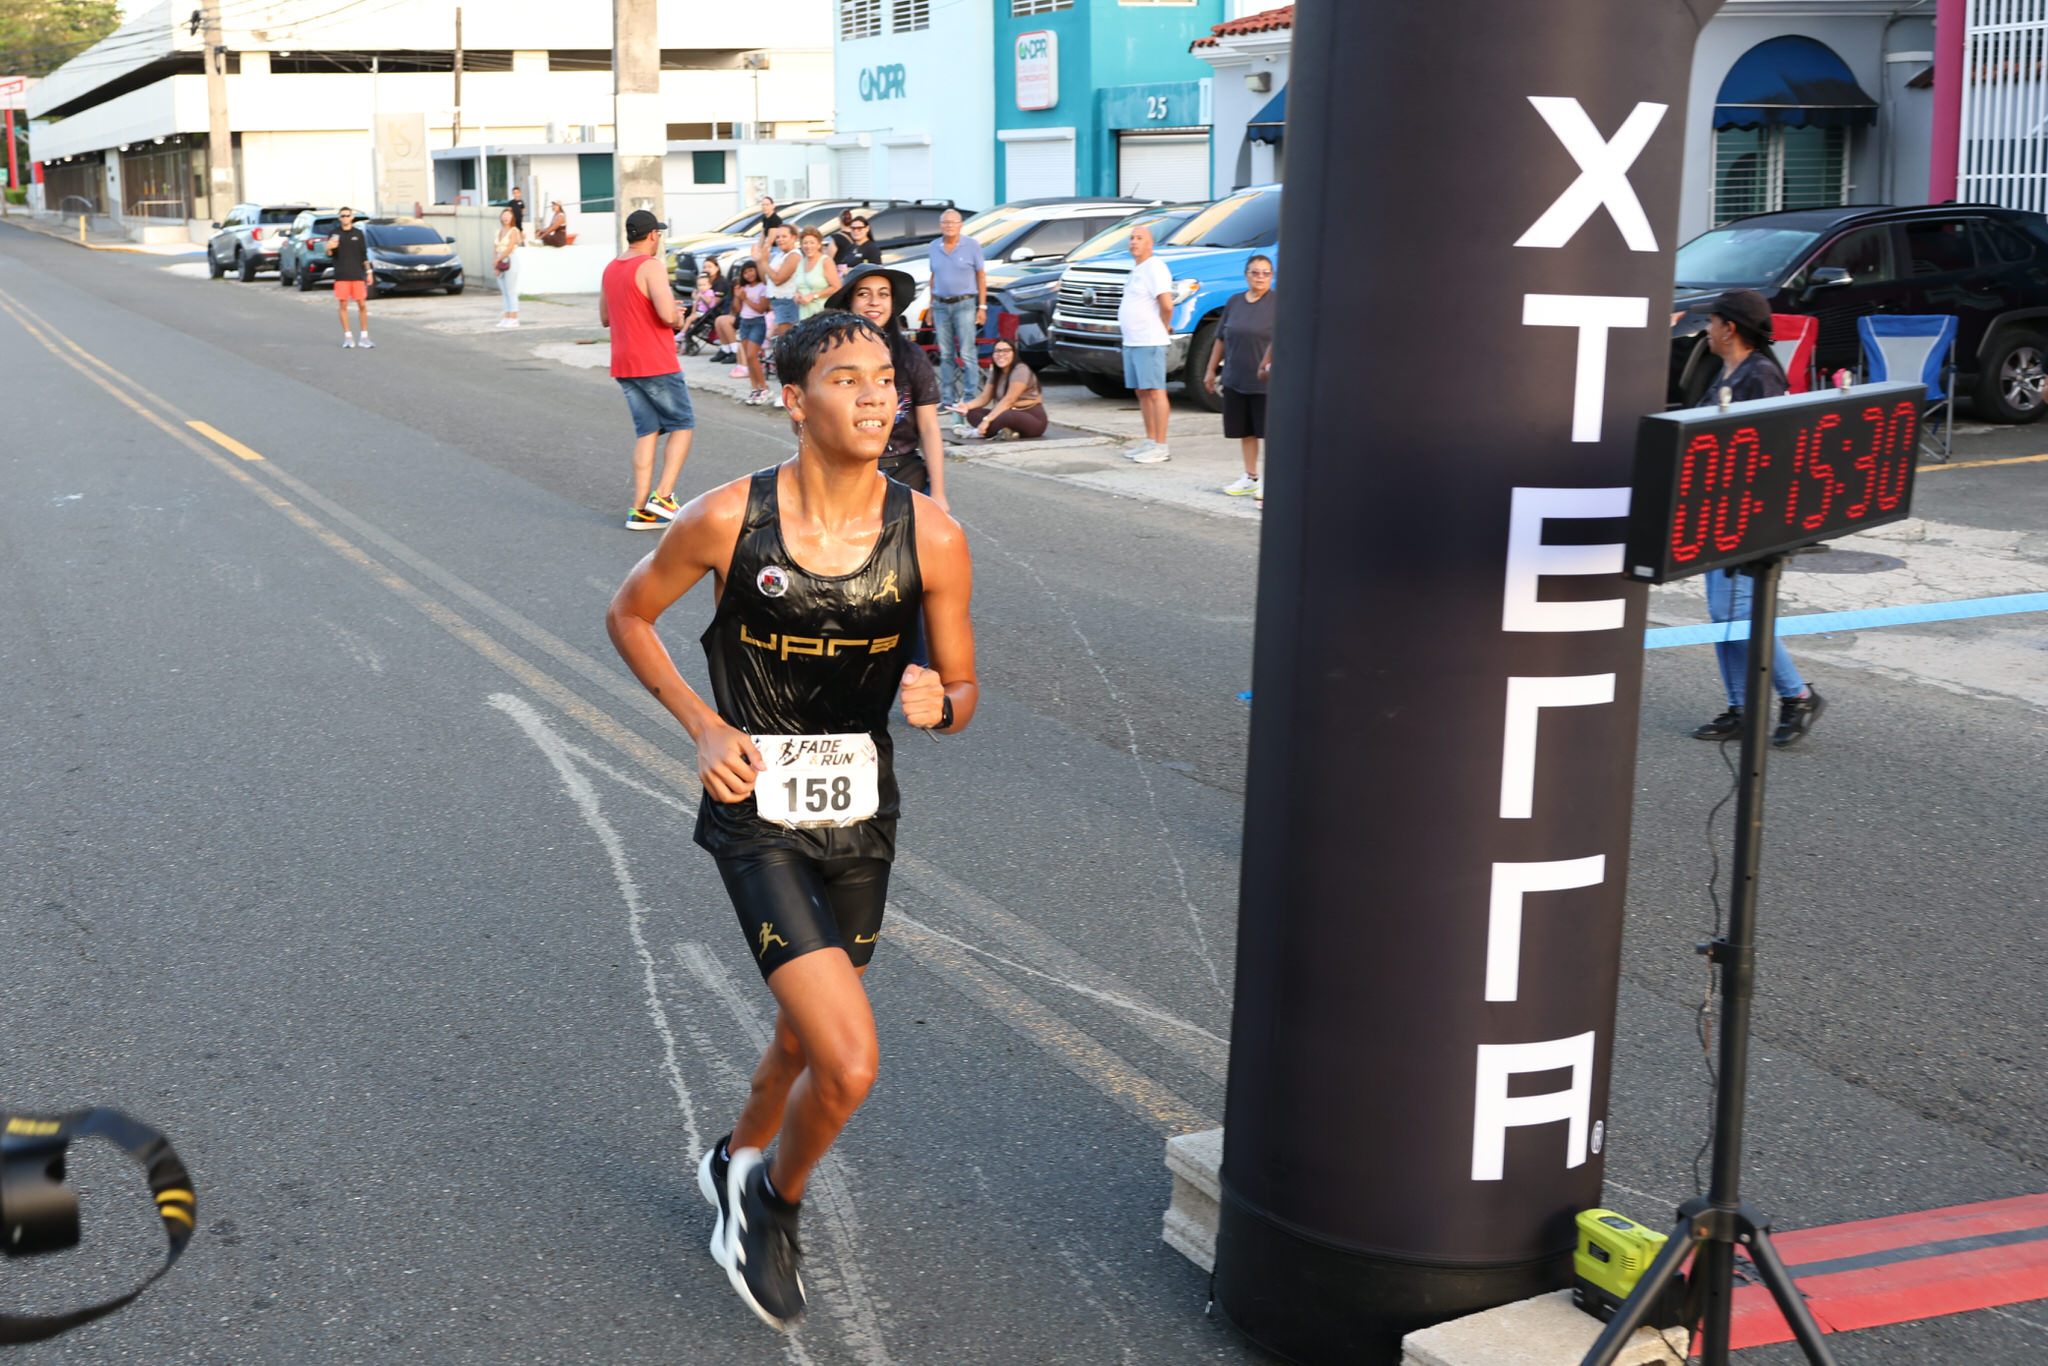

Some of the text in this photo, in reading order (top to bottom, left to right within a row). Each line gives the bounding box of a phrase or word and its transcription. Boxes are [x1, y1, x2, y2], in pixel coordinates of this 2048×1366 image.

[1147, 96, 1168, 119] 25
[1671, 401, 1917, 562] 00:15:30
[798, 739, 842, 754] FADE
[821, 752, 855, 766] RUN
[782, 776, 852, 812] 158
